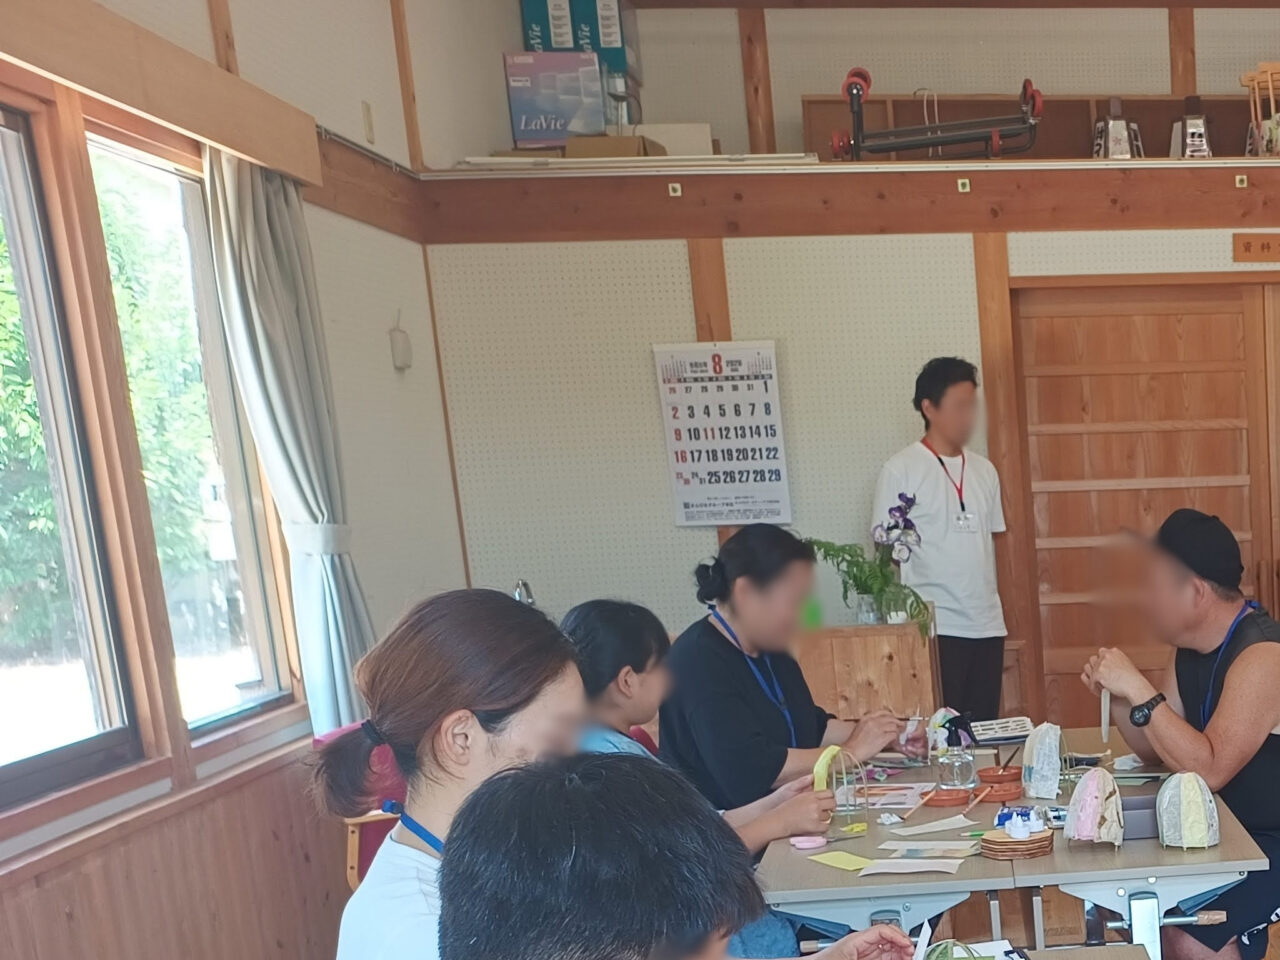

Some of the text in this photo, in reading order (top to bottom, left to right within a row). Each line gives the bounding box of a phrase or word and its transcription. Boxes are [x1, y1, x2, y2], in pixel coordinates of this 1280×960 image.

[520, 114, 566, 130] LaVie
[712, 353, 723, 375] 8
[672, 402, 771, 419] 2 3 4 5 6 7 8
[674, 424, 777, 441] 9 10 11 12 13 14 15
[674, 447, 780, 463] 16 17 18 19 20 21 22
[707, 471, 721, 484] 25
[723, 470, 736, 484] 26
[738, 470, 750, 483] 27
[752, 469, 766, 482] 28
[768, 469, 781, 482] 29
